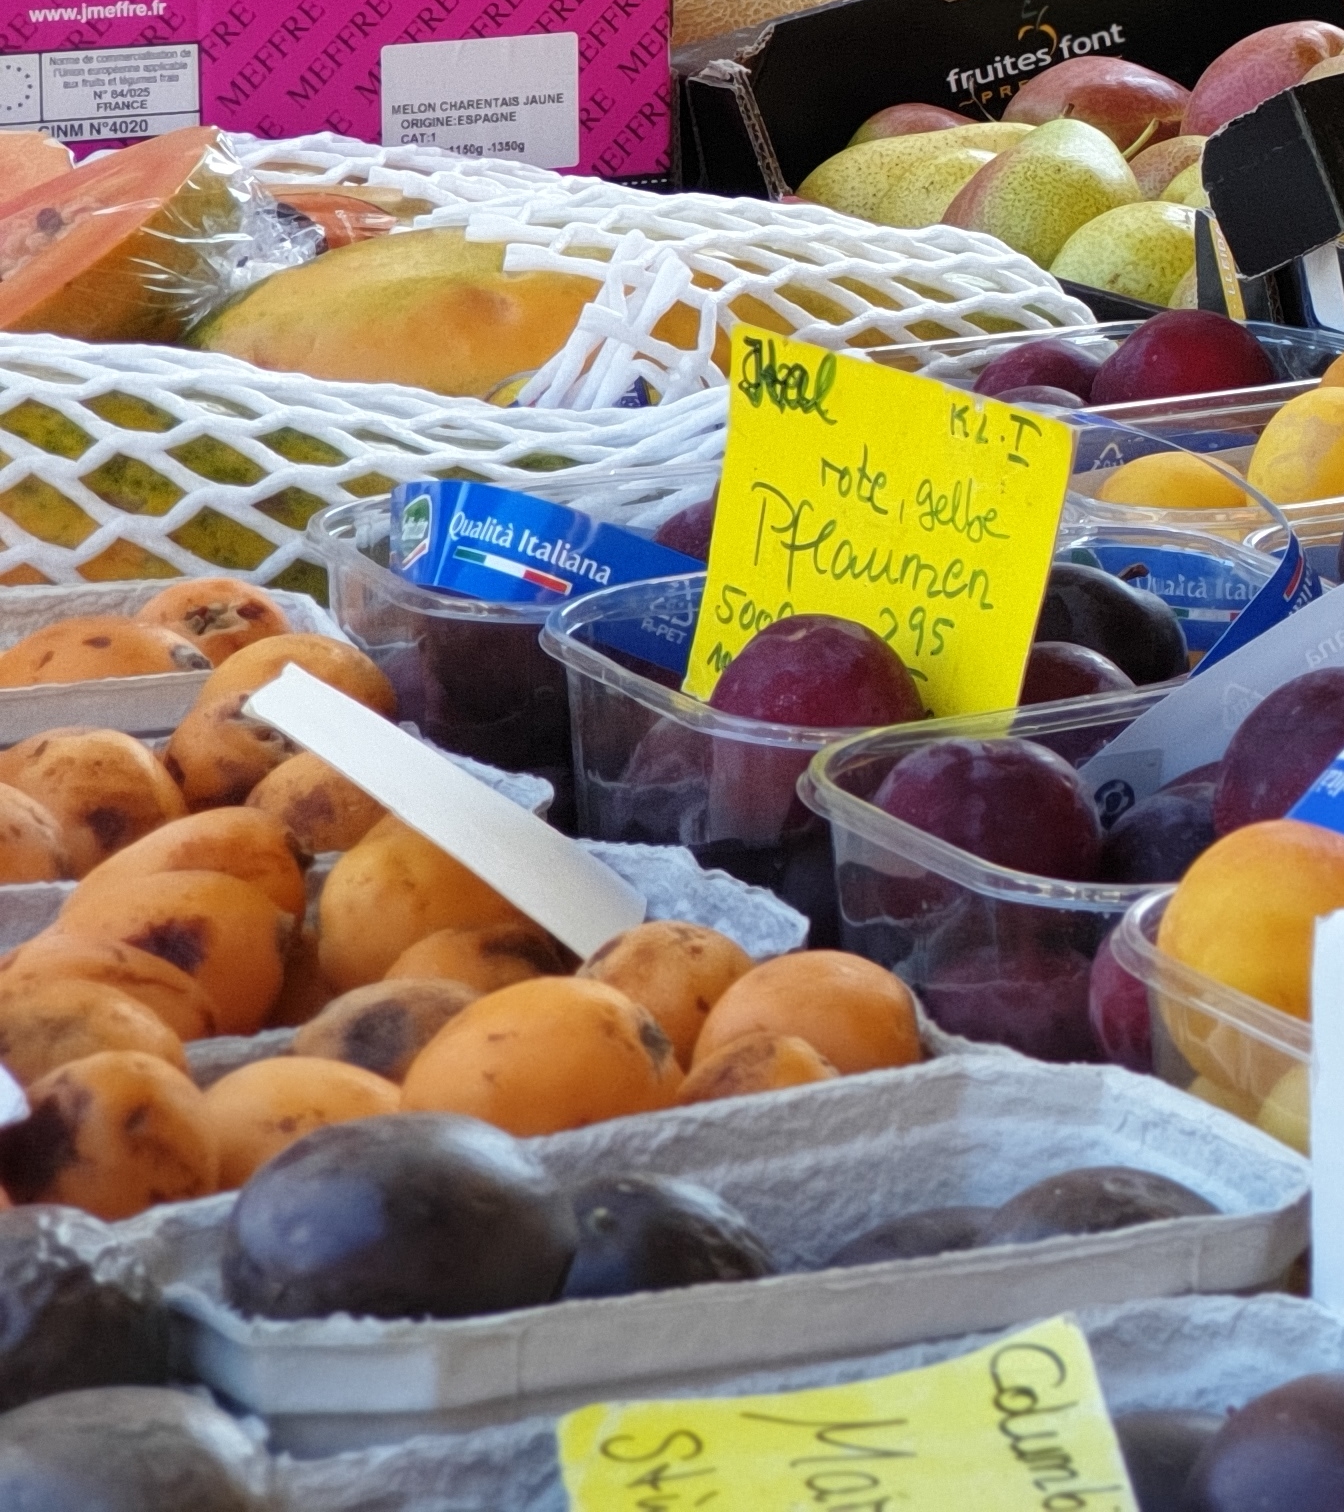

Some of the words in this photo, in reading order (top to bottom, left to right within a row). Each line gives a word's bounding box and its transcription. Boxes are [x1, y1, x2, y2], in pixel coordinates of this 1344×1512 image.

[29, 0, 168, 25] www.jmeffre.fr
[946, 47, 1051, 93] fruites
[1059, 23, 1126, 60] font
[81, 77, 106, 88] fruits
[96, 99, 148, 112] FRANCE
[391, 101, 436, 116] MELON
[439, 96, 520, 112] CHARENTAIS
[523, 93, 565, 106] JAUNE
[89, 119, 149, 136] N°4020
[916, 477, 1010, 542] gelbe
[449, 511, 514, 548] Qualità
[517, 528, 612, 586] Italiana
[751, 481, 995, 611] Pflaumen
